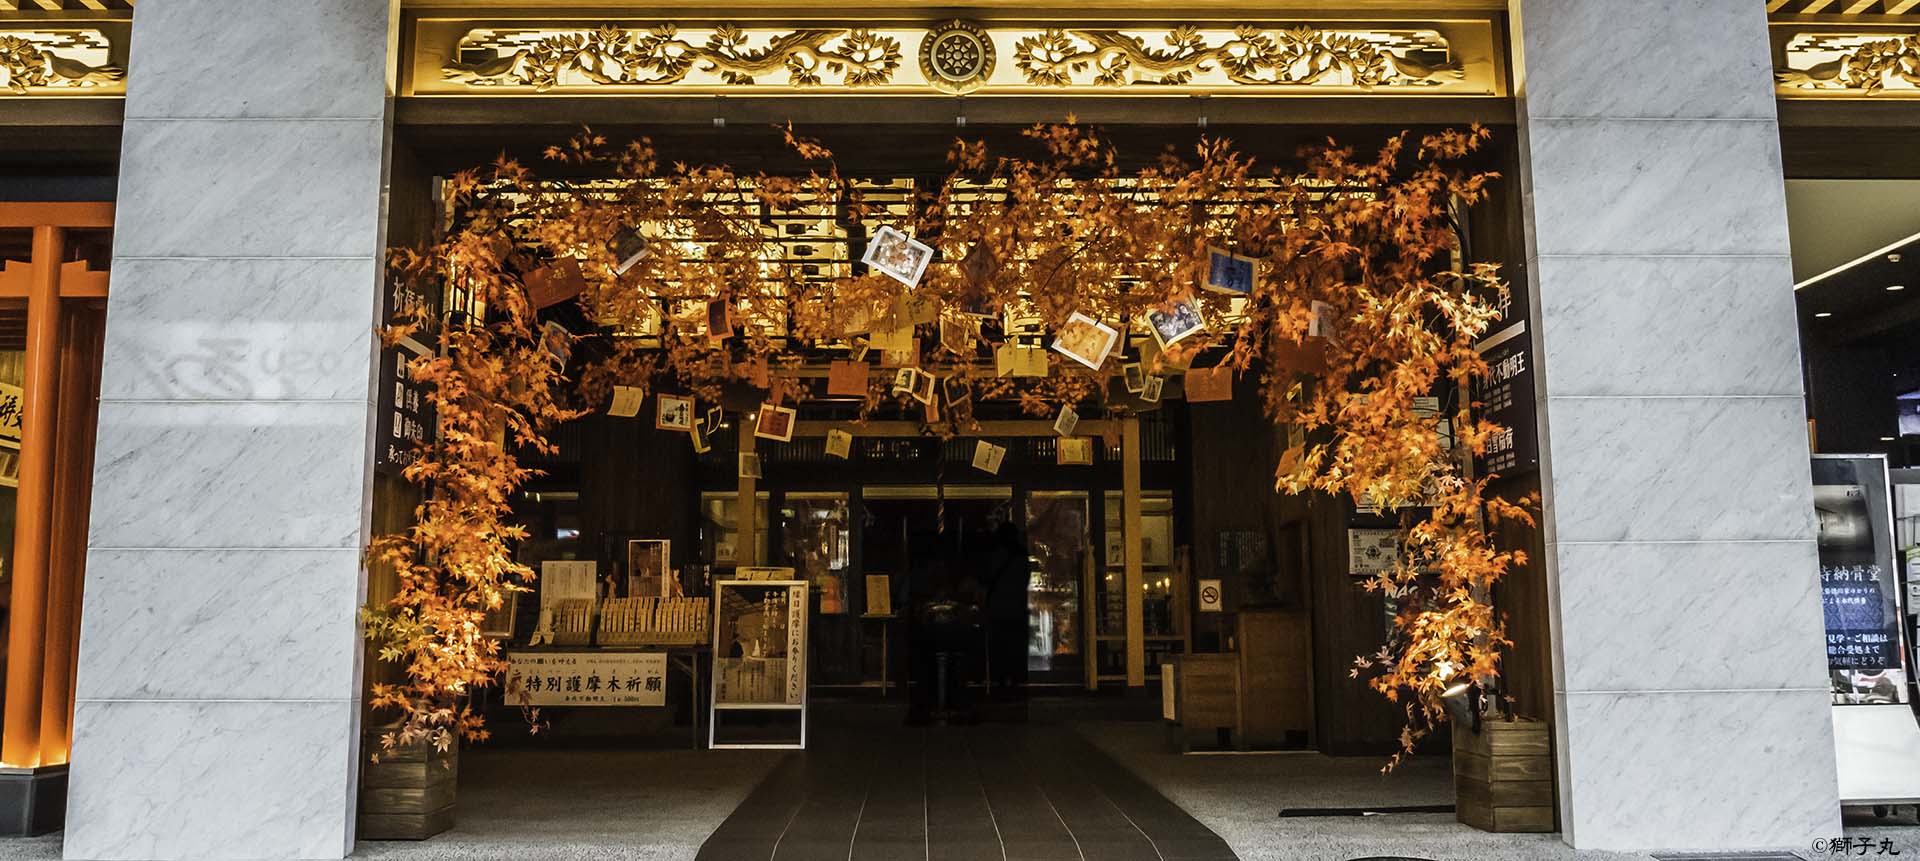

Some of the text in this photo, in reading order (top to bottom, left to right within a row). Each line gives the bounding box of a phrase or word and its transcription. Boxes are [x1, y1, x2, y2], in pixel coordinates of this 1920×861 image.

[525, 675, 662, 693] 特別護摩木祈願
